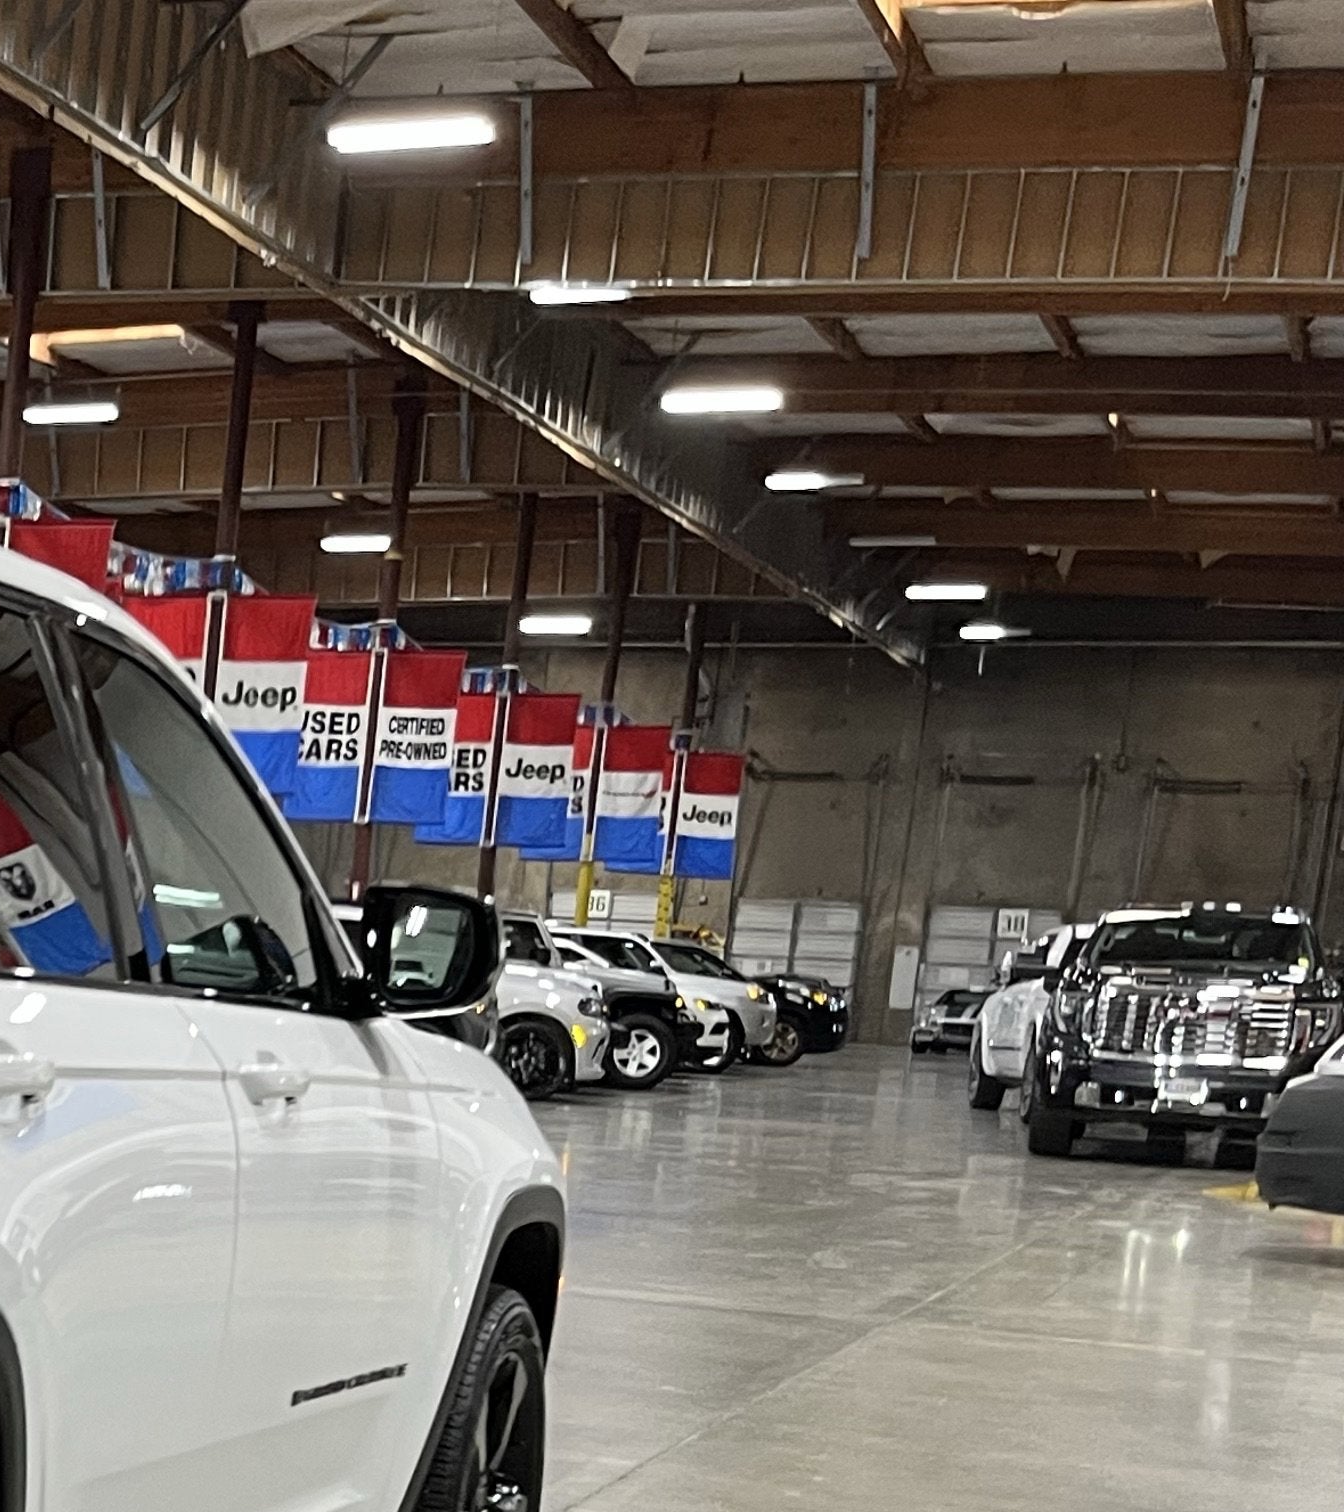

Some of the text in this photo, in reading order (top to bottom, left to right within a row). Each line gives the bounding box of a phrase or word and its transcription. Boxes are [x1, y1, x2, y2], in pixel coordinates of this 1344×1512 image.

[222, 680, 297, 712] Jeep
[388, 715, 445, 736] CERTIFIED
[298, 738, 358, 762] ARS
[379, 739, 447, 761] PRE-OWNED
[453, 747, 487, 770] ED
[505, 757, 565, 784] Jeep
[449, 771, 485, 793] RS
[682, 804, 732, 826] Jeep
